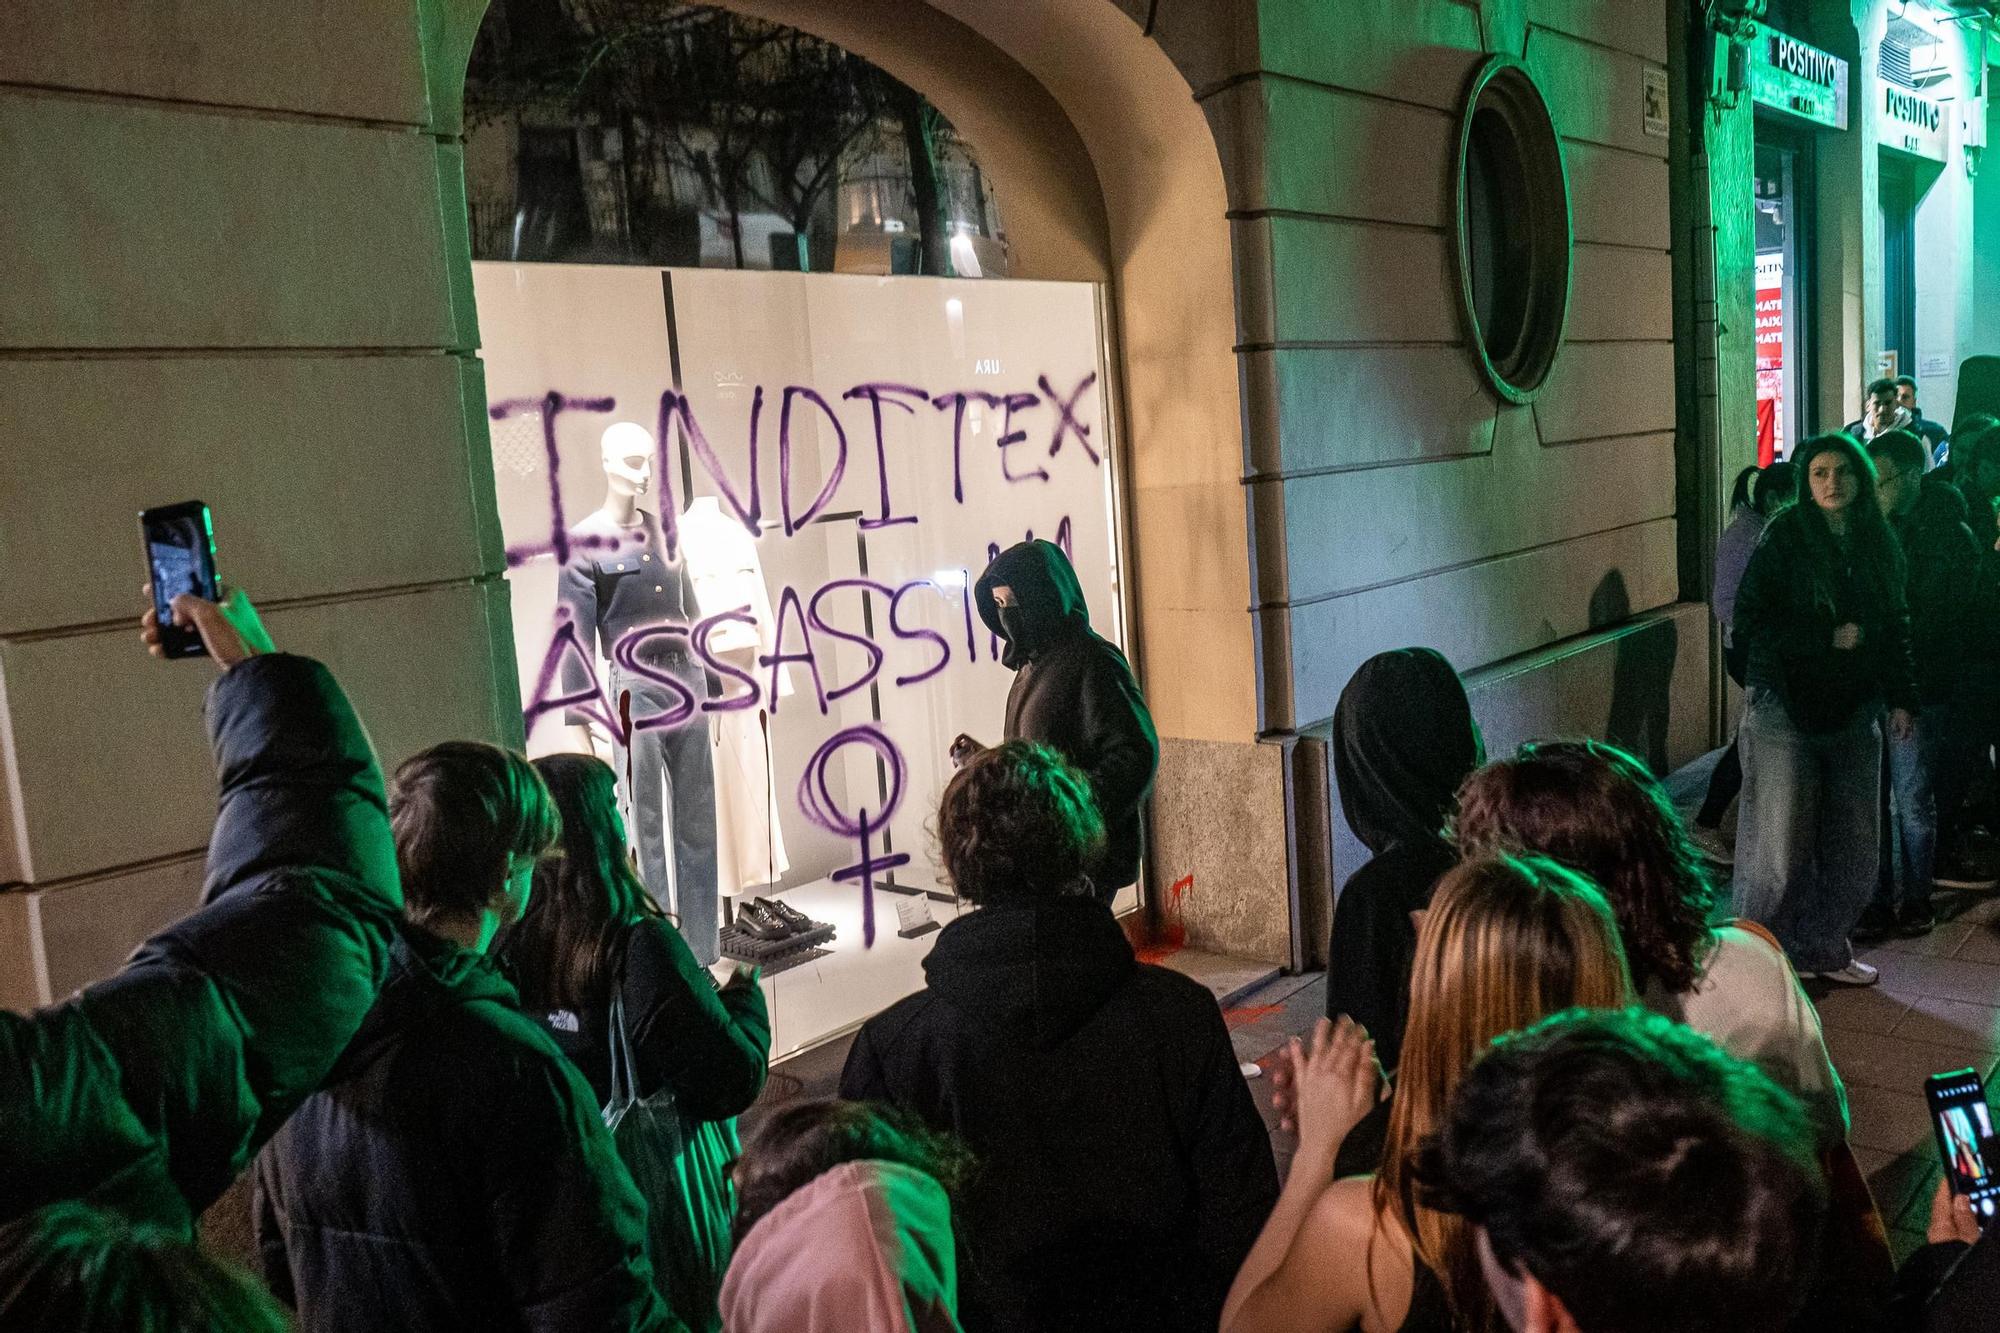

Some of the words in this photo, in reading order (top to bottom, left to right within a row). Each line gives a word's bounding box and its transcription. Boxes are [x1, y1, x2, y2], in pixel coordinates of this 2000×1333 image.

[1779, 36, 1837, 86] POSITIVO
[1886, 87, 1940, 133] POSITIVO
[489, 371, 1100, 566] INDITEX
